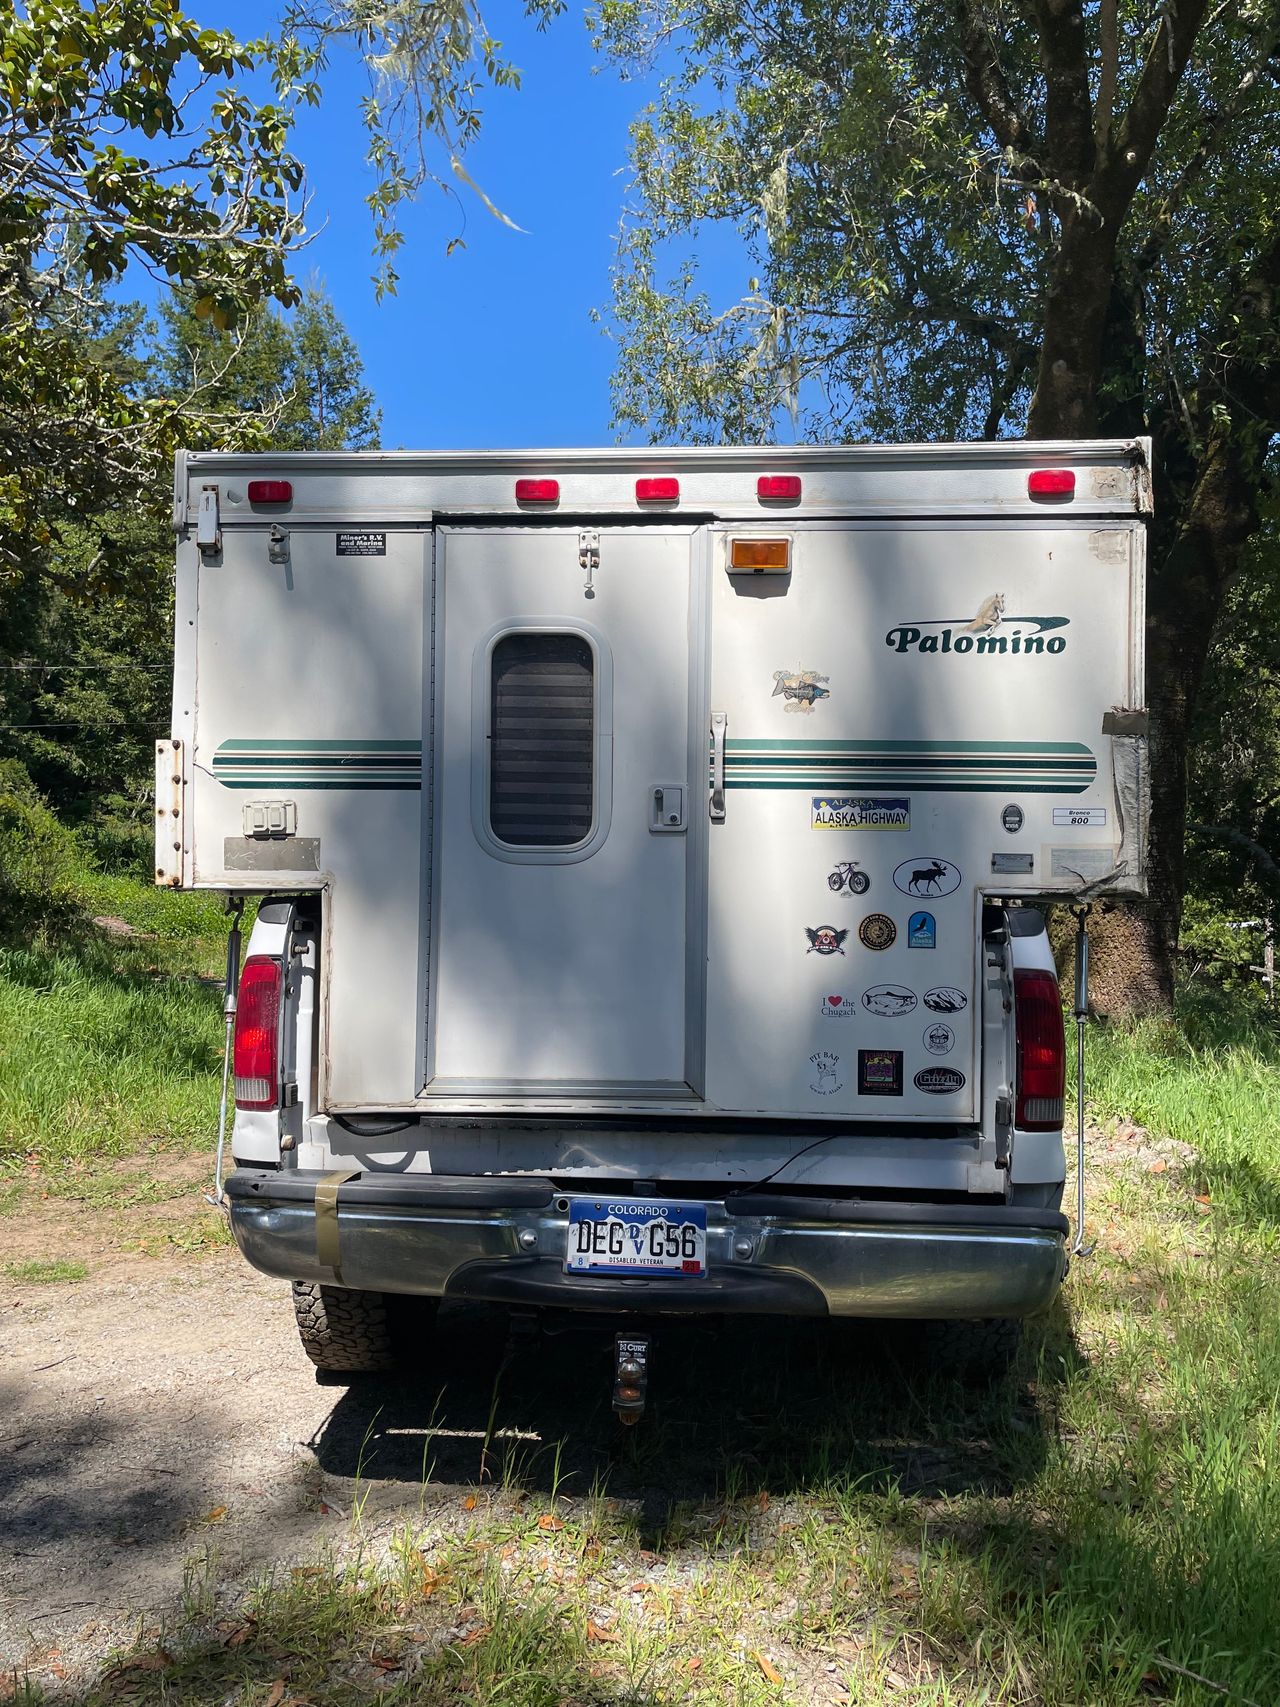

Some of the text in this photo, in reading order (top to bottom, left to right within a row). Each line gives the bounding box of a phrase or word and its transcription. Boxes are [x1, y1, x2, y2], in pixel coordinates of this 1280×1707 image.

[886, 628, 1067, 654] Palomino
[815, 812, 907, 825] ALASKA HIGHWAY
[1070, 817, 1089, 825] 800
[822, 998, 855, 1007] I the
[821, 1008, 856, 1018] Chugach
[810, 1052, 840, 1062] PIT BAR
[919, 1074, 960, 1085] Grizzly
[608, 1204, 669, 1217] COLORADO
[576, 1220, 624, 1255] DEG
[650, 1223, 697, 1259] G56
[577, 1257, 584, 1265] 8
[627, 1343, 646, 1352] CURT
